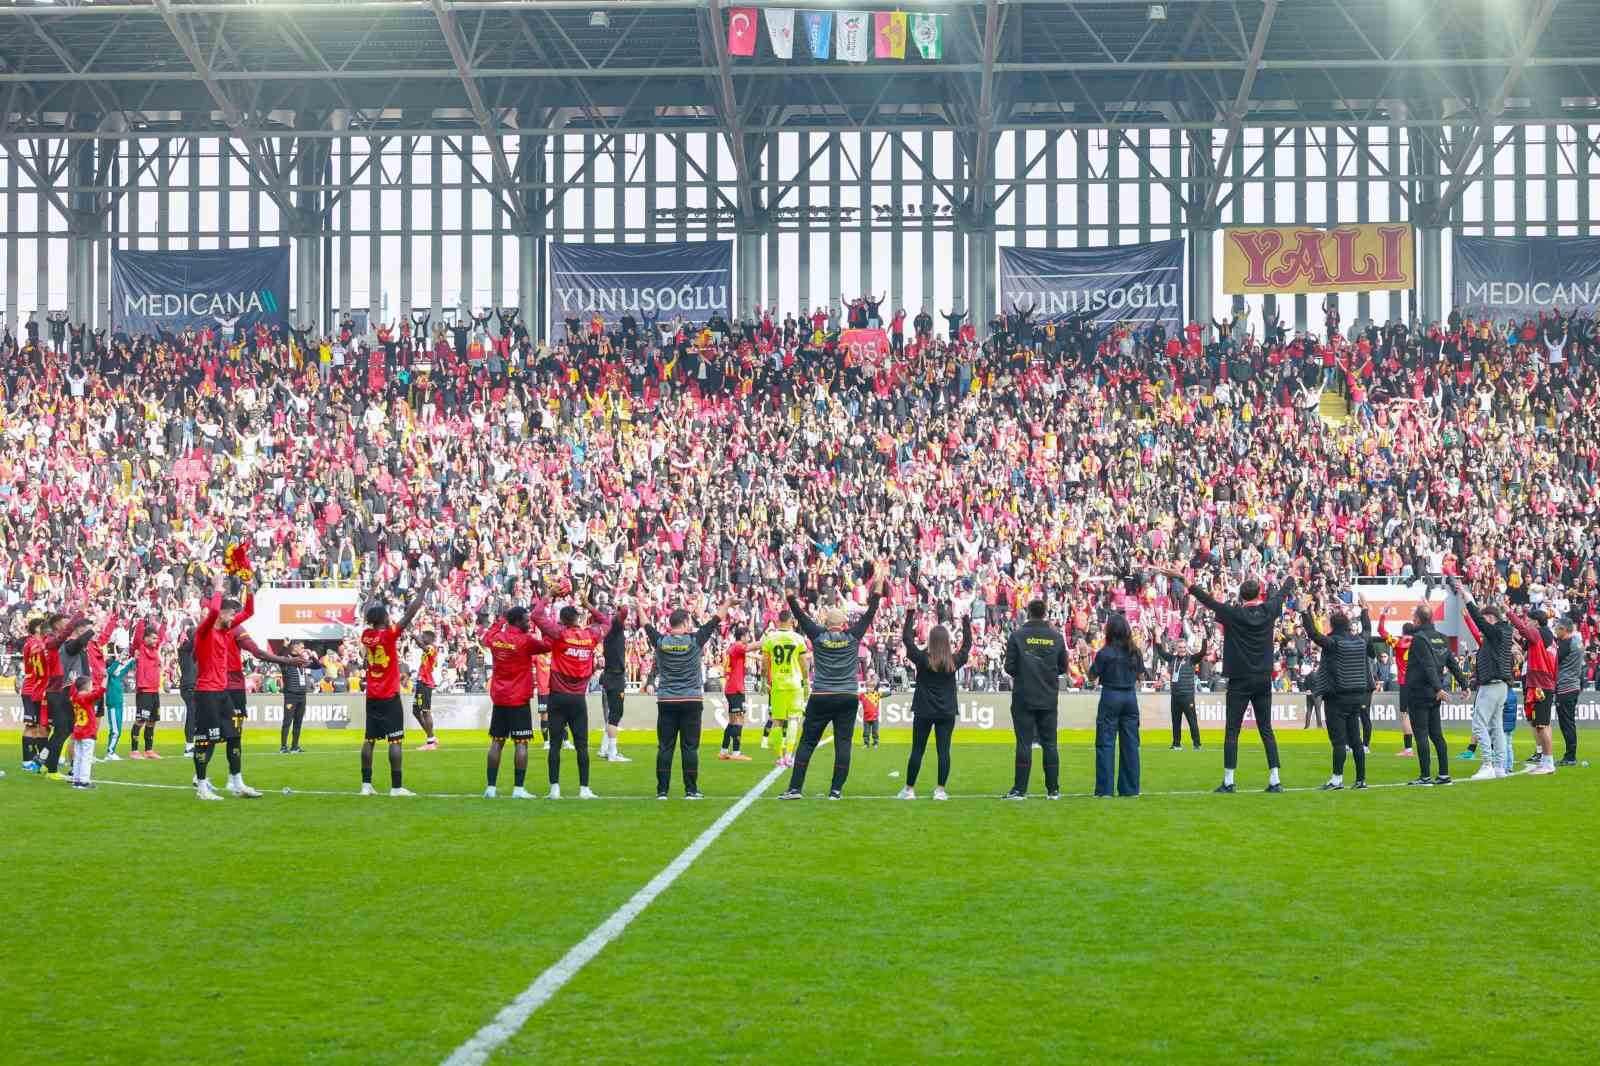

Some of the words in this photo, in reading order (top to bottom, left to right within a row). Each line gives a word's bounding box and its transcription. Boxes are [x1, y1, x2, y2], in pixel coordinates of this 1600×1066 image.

[1231, 226, 1407, 287] YALI
[124, 290, 264, 317] MEDICANA
[557, 283, 728, 311] YUNUSOĞLU
[773, 644, 797, 665] 97
[960, 701, 995, 729] Lig
